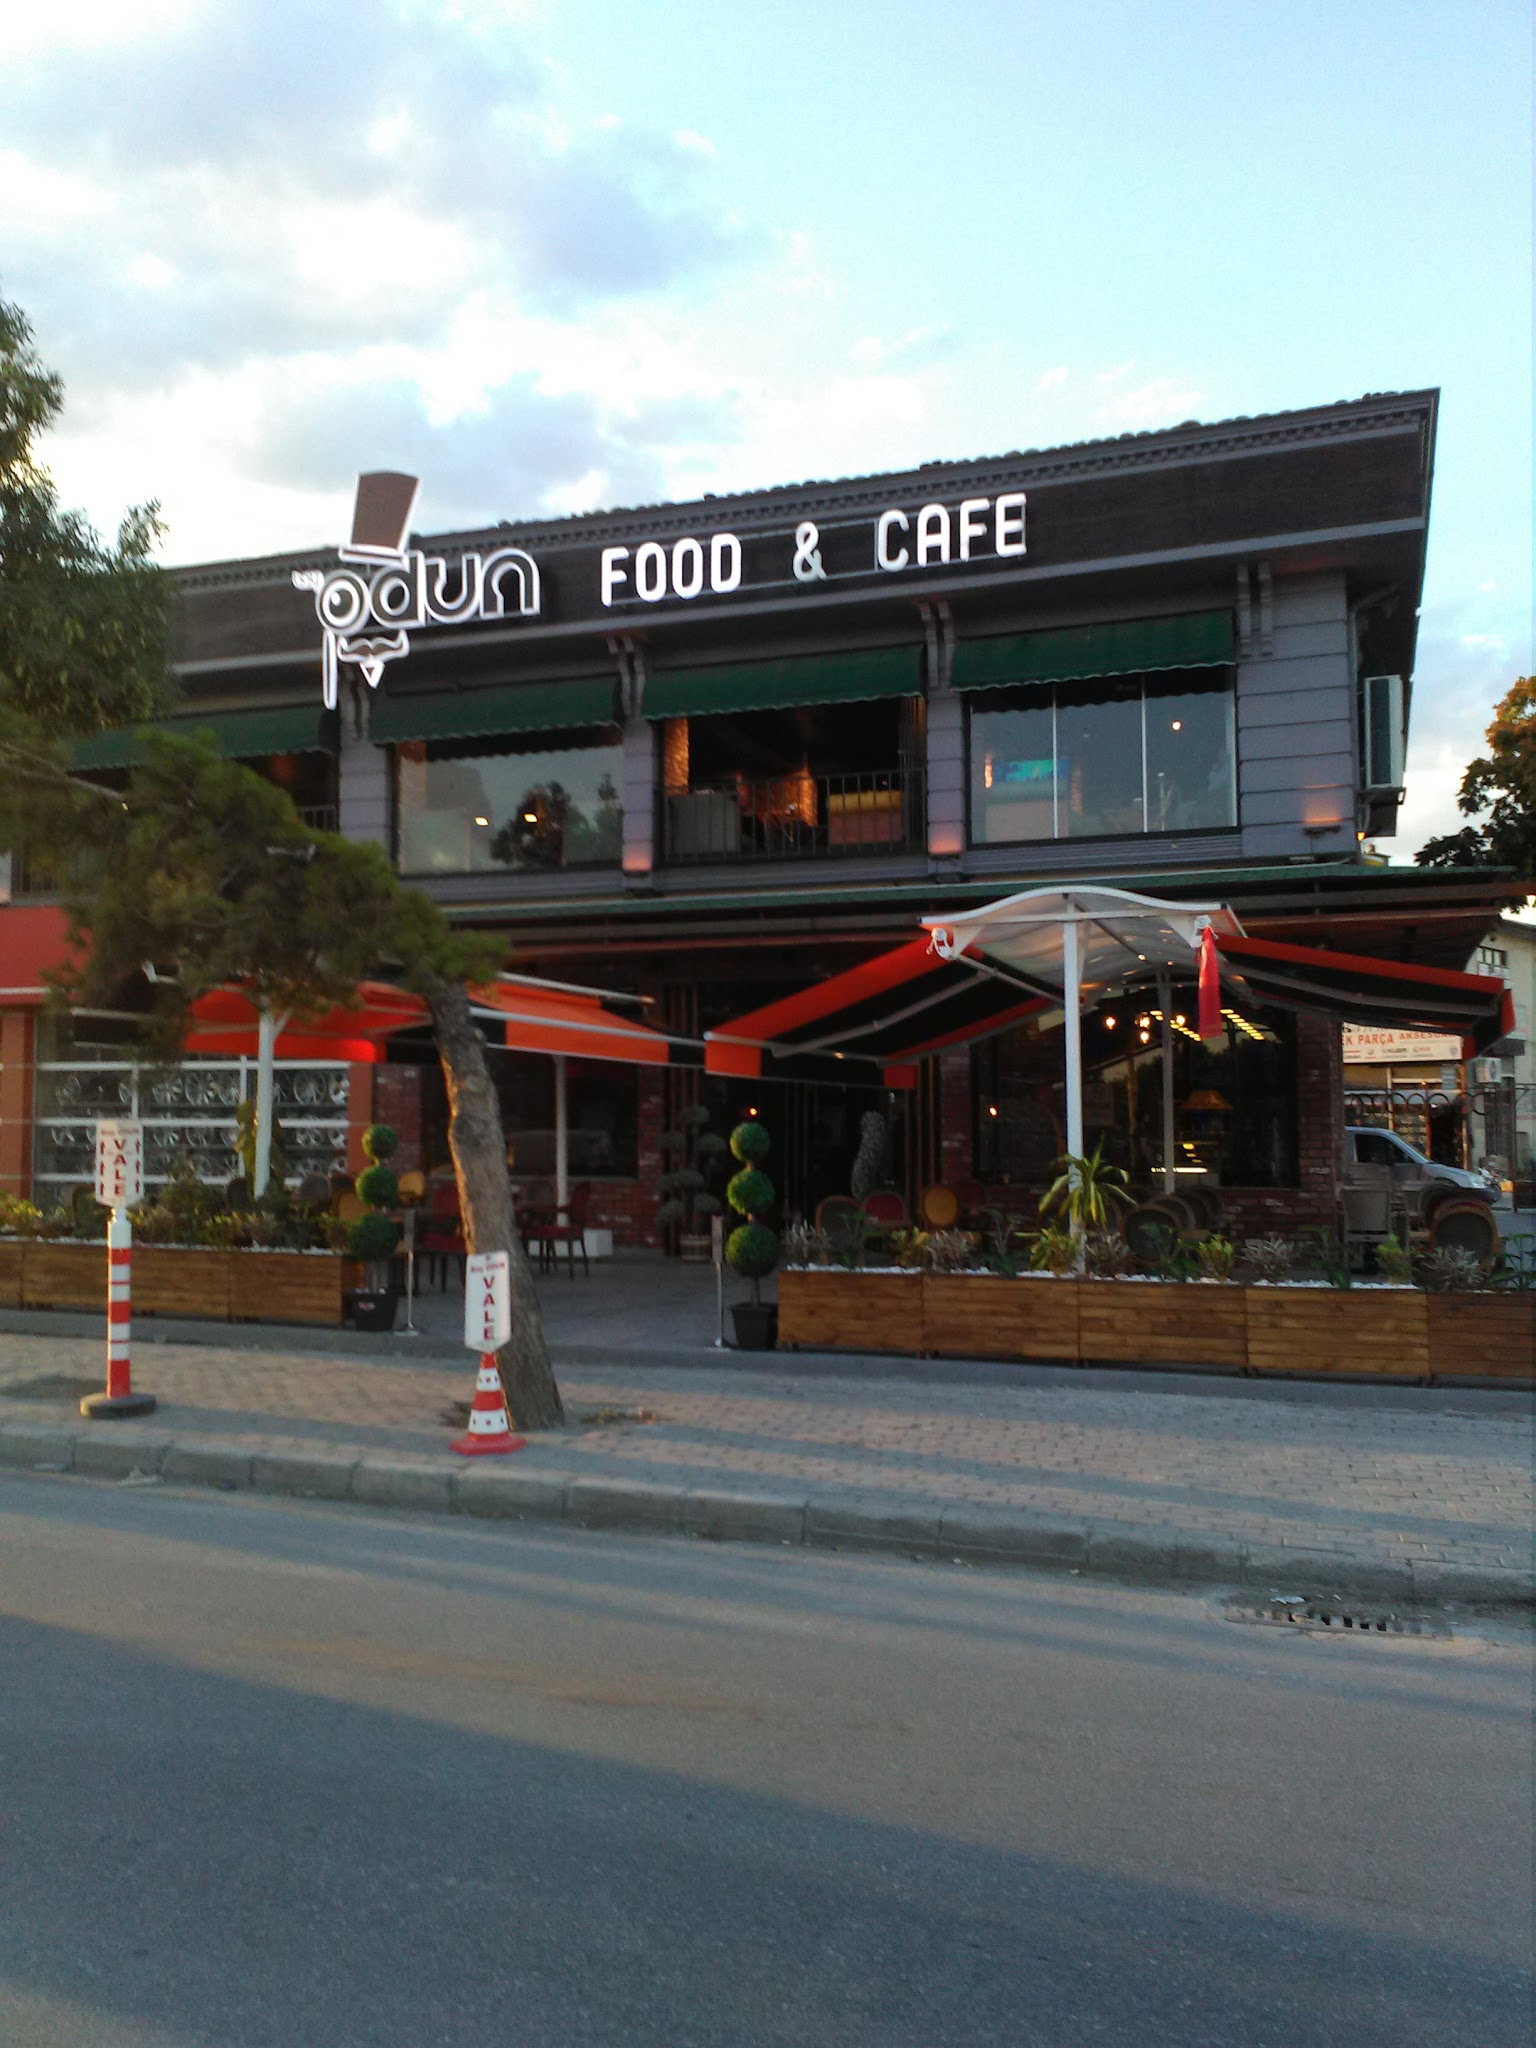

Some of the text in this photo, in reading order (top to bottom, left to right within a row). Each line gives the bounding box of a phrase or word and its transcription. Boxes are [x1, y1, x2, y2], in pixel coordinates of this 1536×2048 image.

[601, 532, 742, 608] FOOD
[793, 521, 828, 582] &
[877, 492, 1027, 573] CAFE
[1358, 1033, 1394, 1046] PARÇA
[113, 1139, 127, 1197] VALE
[483, 1275, 495, 1341] VALE
